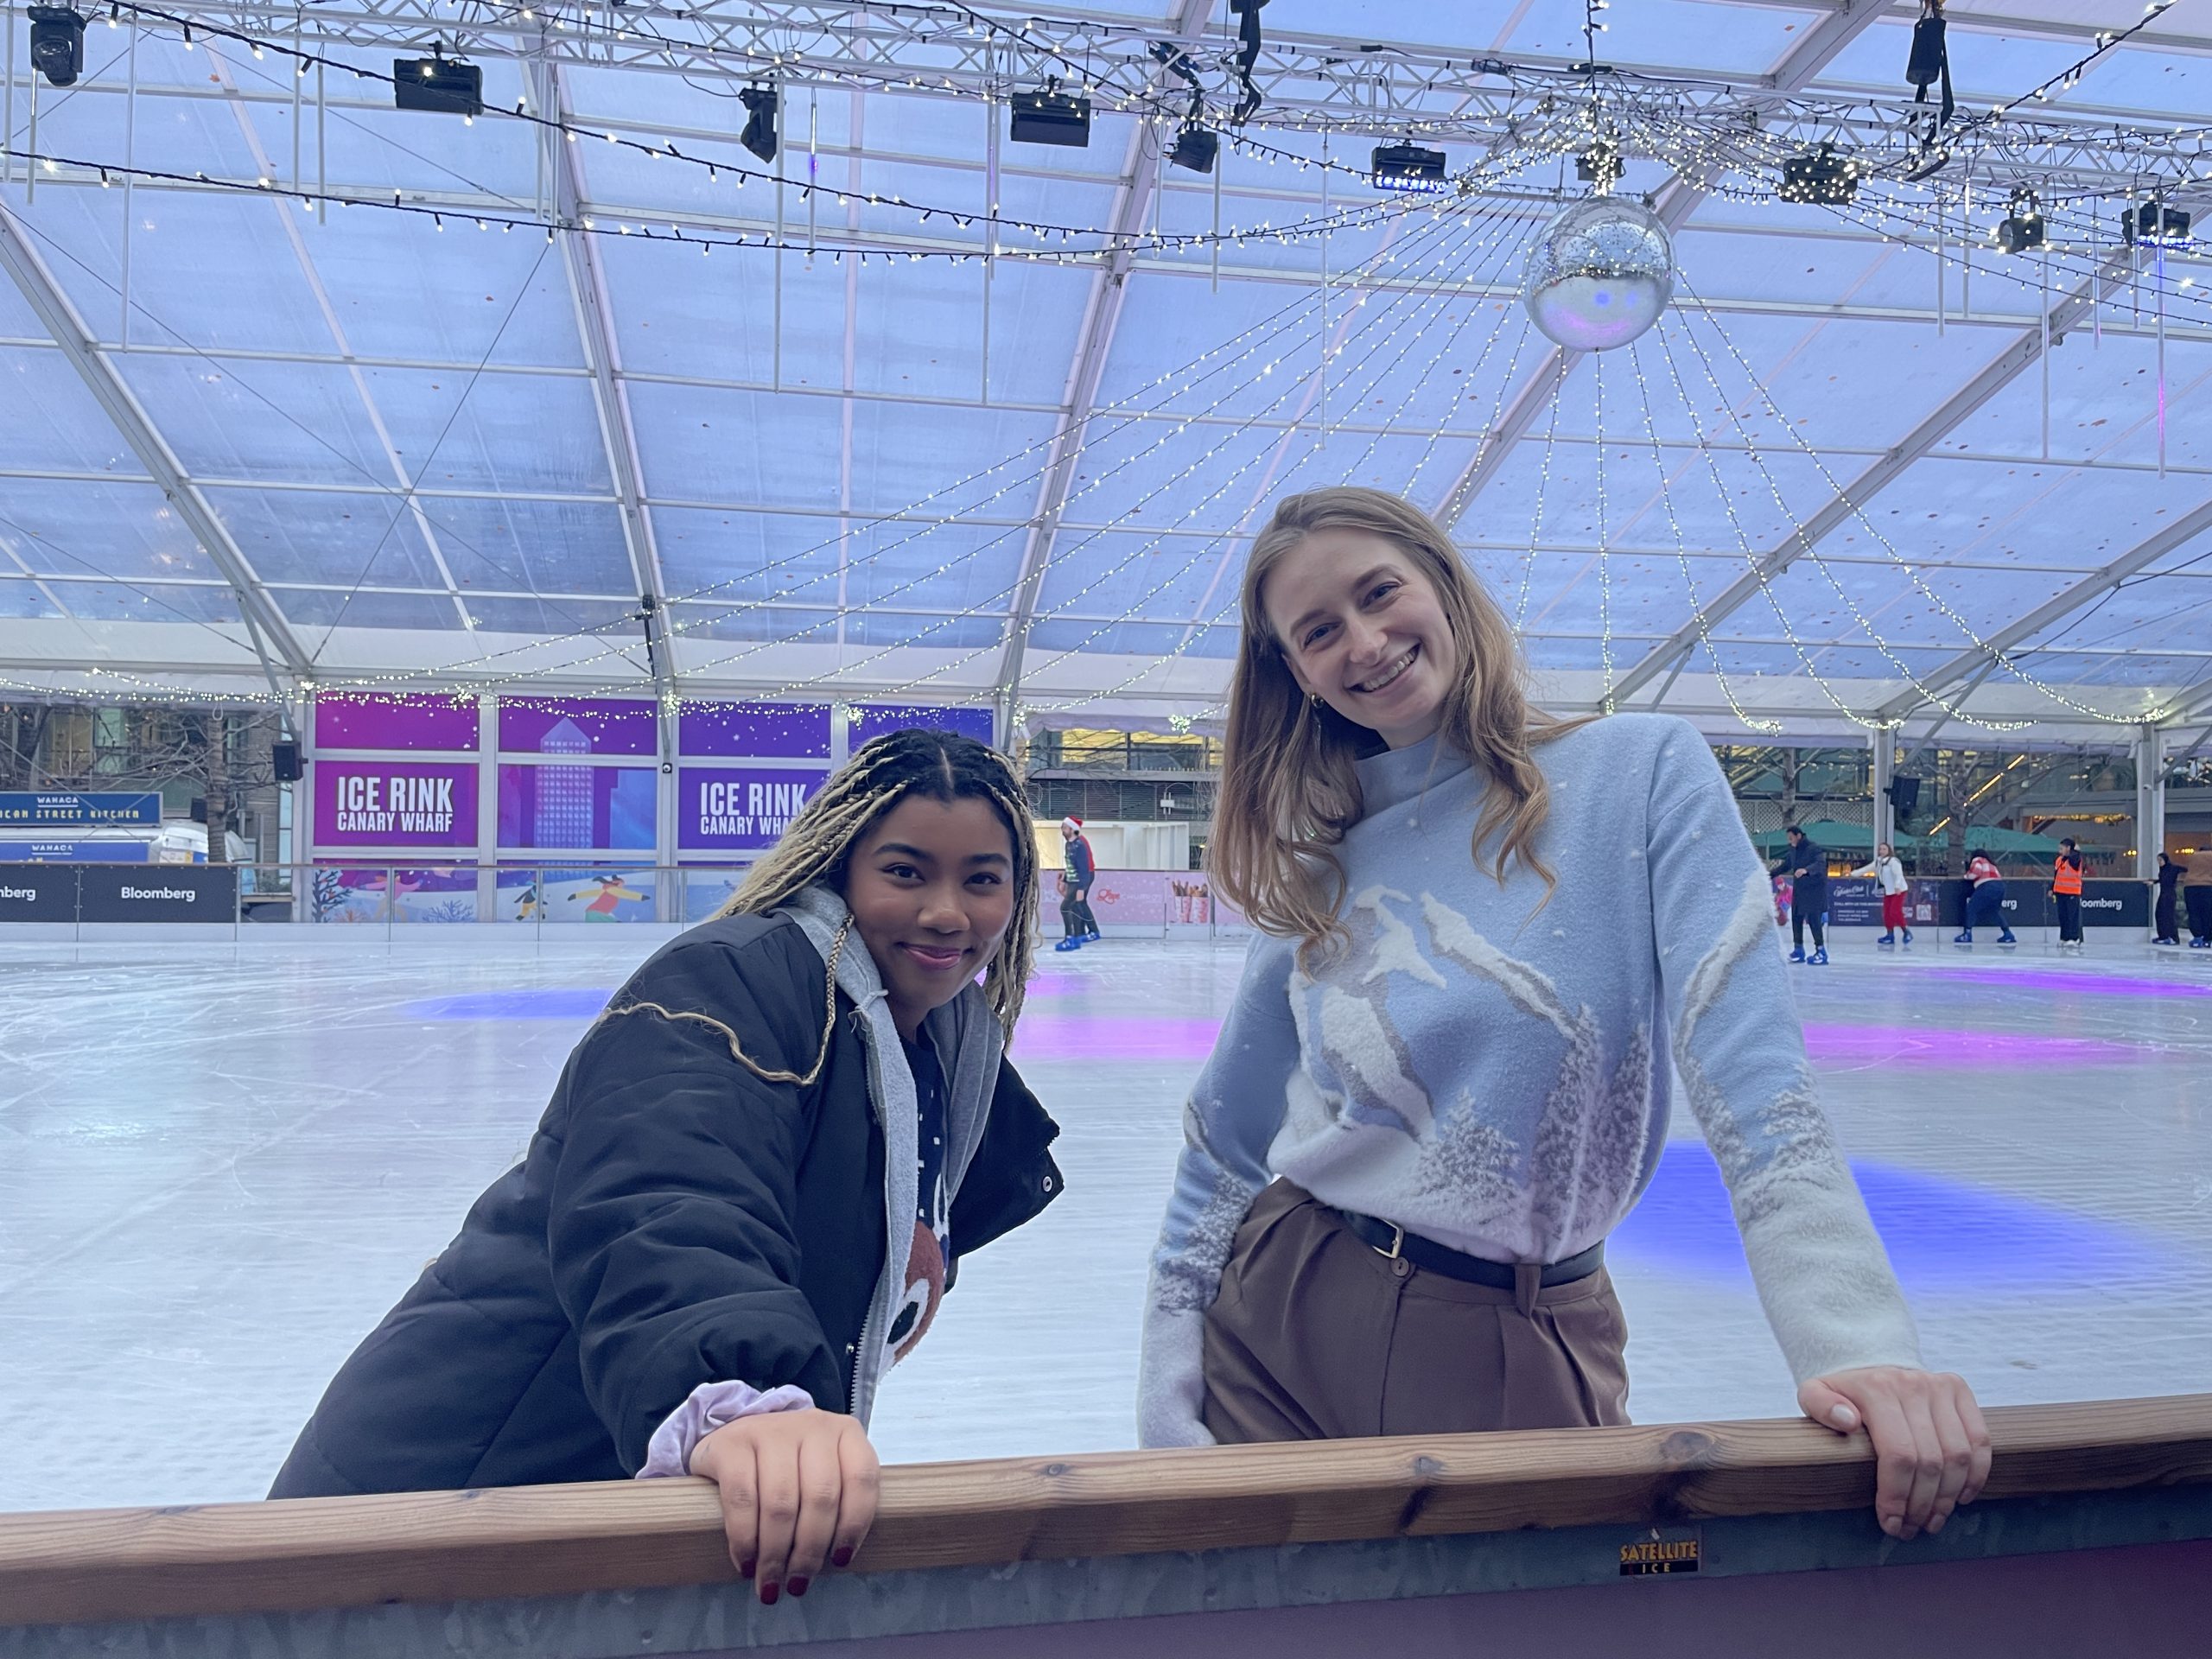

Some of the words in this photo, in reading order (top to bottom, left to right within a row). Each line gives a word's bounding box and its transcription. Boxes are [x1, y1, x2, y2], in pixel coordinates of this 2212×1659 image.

[36, 796, 79, 804] WAHACA
[338, 777, 381, 811] ICE
[390, 778, 454, 812] RINK
[701, 782, 741, 817] ICE
[748, 783, 807, 817] RINK
[36, 810, 83, 819] STREET
[90, 810, 140, 820] KITCHEN
[337, 811, 395, 831] CANARY
[400, 812, 453, 832] WHARF
[700, 816, 753, 836] CANARY
[759, 817, 796, 836] WHA
[121, 887, 195, 902] Bloomberg
[2079, 897, 2122, 911] loomberg
[1619, 1541, 1698, 1562] SATELLITE
[1642, 1562, 1671, 1573] ICE
